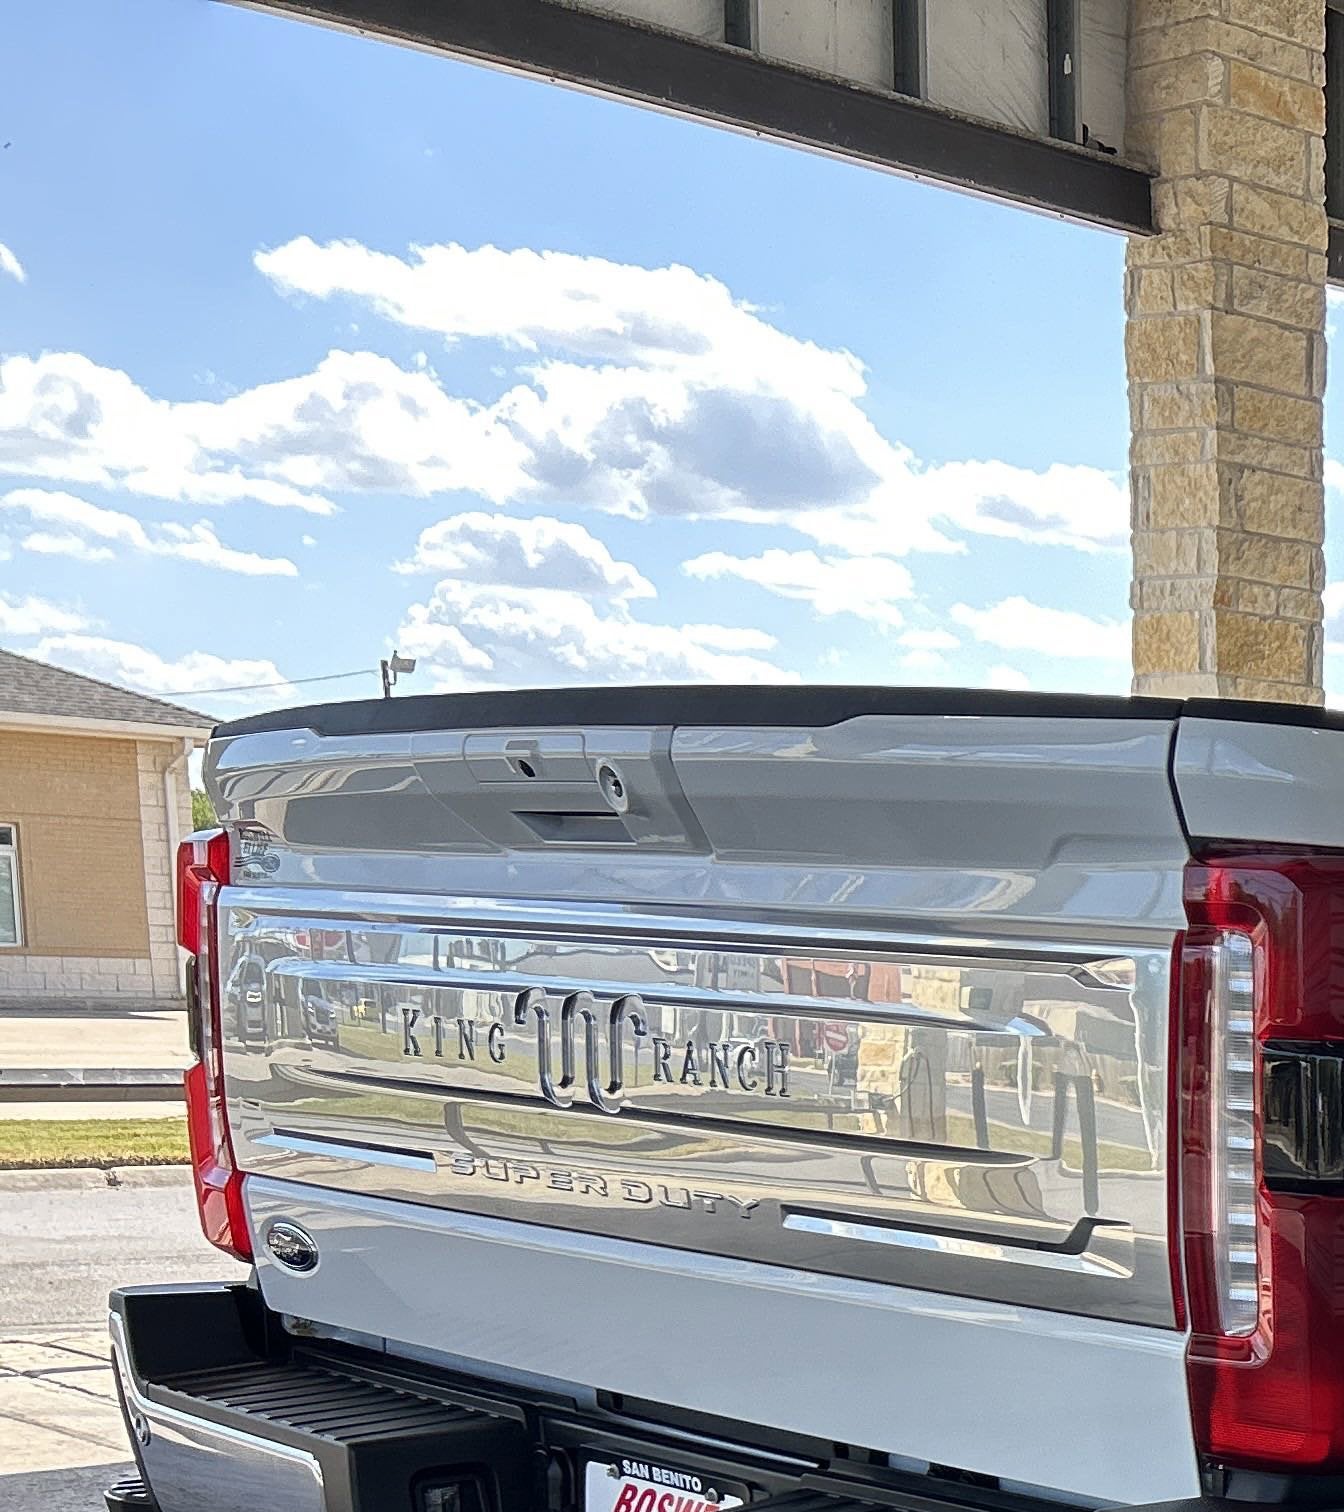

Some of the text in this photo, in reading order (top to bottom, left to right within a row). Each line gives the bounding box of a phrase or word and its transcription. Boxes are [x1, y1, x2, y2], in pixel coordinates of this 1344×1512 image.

[401, 1007, 791, 1098] KING RANCH
[450, 1152, 761, 1219] SUPER DUTY
[621, 1459, 702, 1492] SAN BENITO
